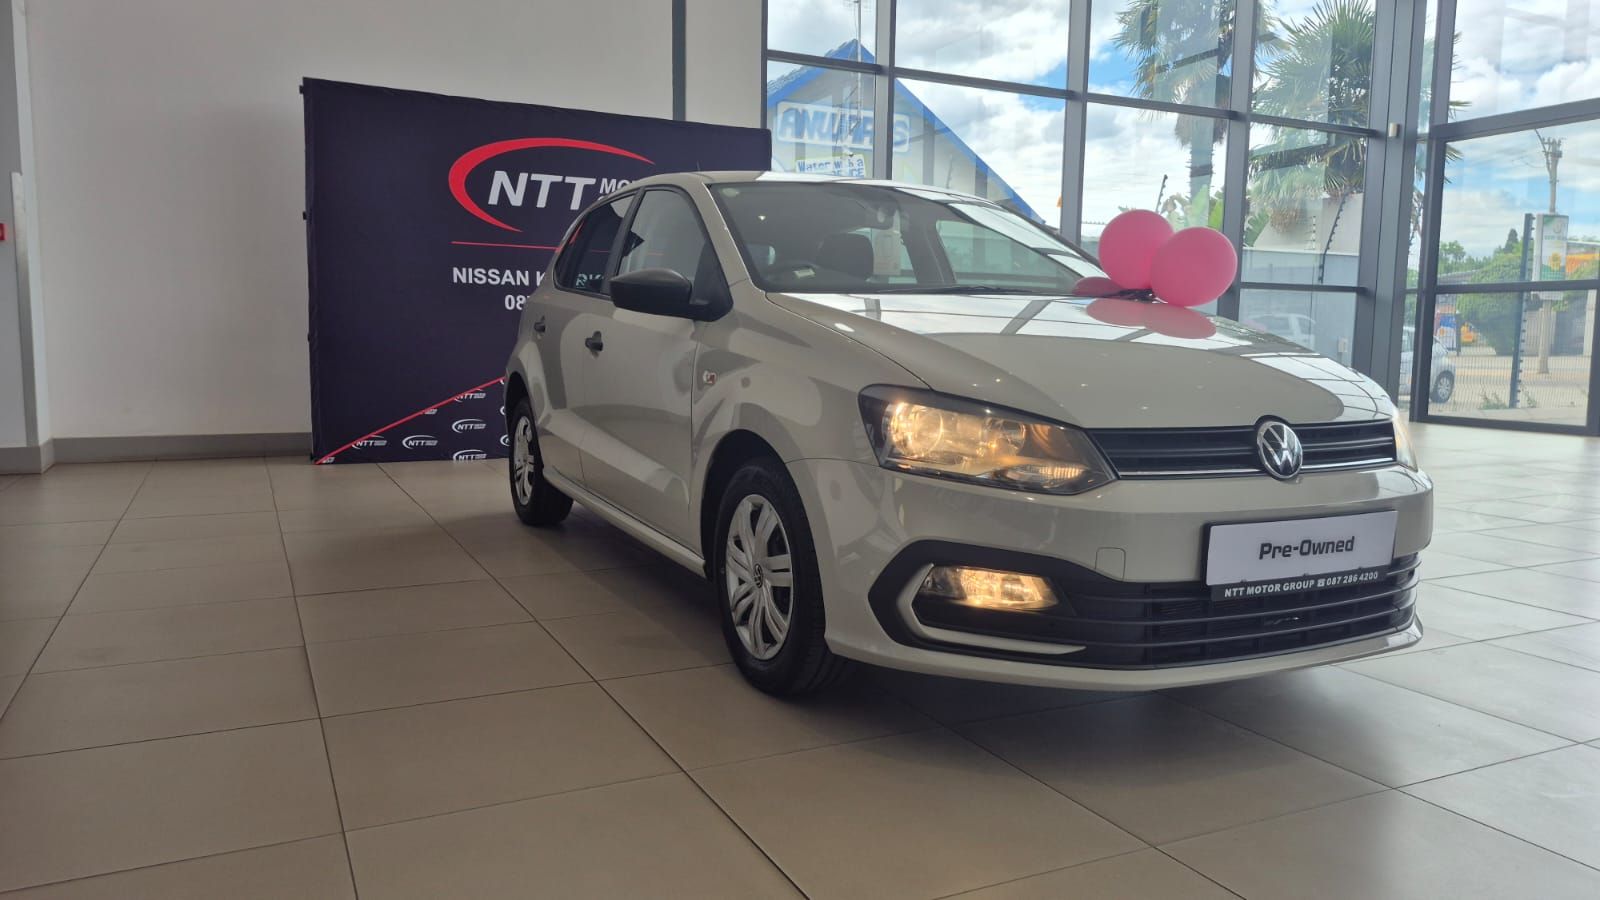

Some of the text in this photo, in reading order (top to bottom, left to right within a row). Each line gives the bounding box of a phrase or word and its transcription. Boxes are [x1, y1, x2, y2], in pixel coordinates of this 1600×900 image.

[488, 170, 597, 211] NTT
[453, 267, 529, 286] NISSAN
[1258, 535, 1355, 561] Pre-Owned
[1224, 571, 1379, 598] NTT MOTOR GROUP 087 286 4200
